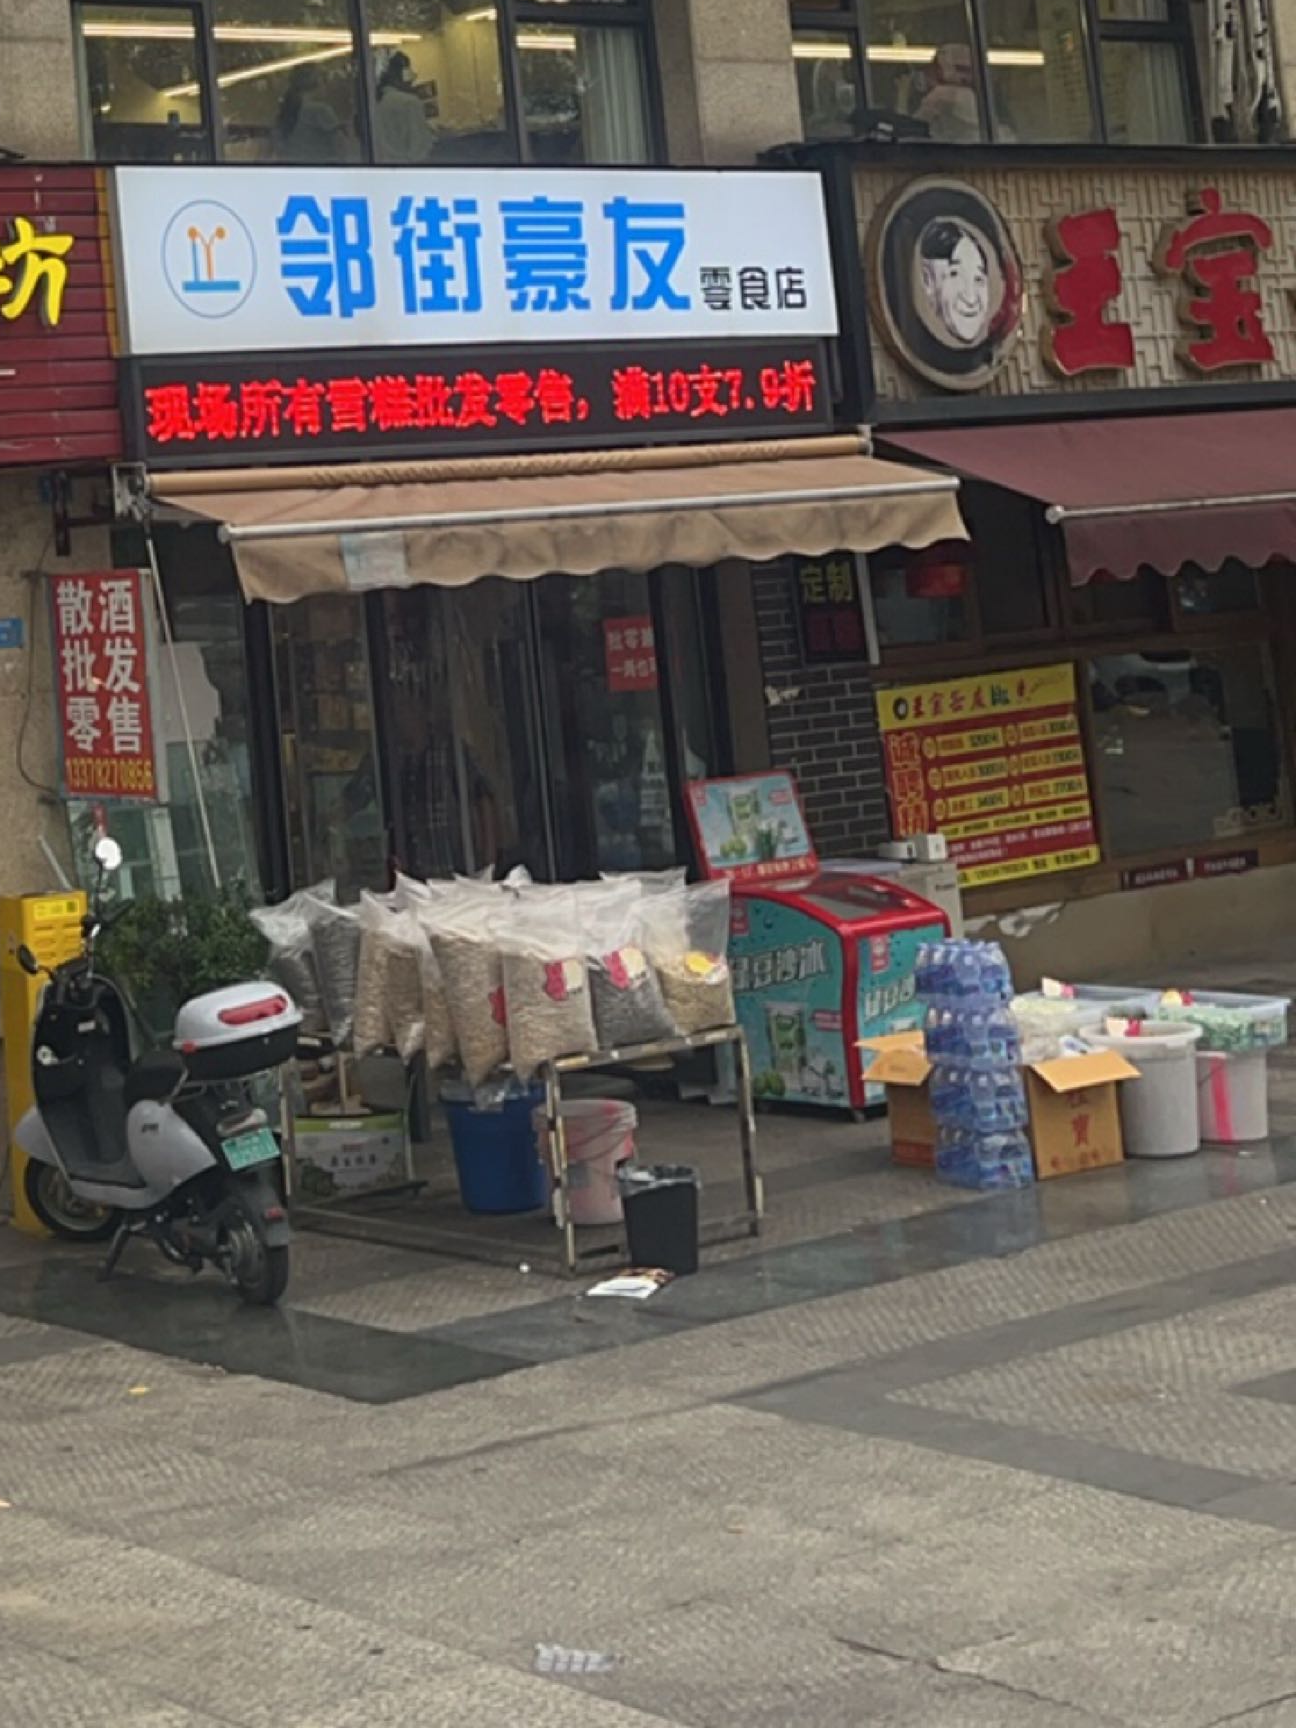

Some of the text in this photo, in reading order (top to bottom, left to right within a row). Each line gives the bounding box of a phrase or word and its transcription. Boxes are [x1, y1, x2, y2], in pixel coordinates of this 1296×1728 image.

[276, 196, 691, 318] 邻街豪友
[699, 266, 808, 310] 零食店
[57, 579, 136, 634] 散酒
[62, 636, 141, 693] 批发
[66, 697, 143, 753] 零售
